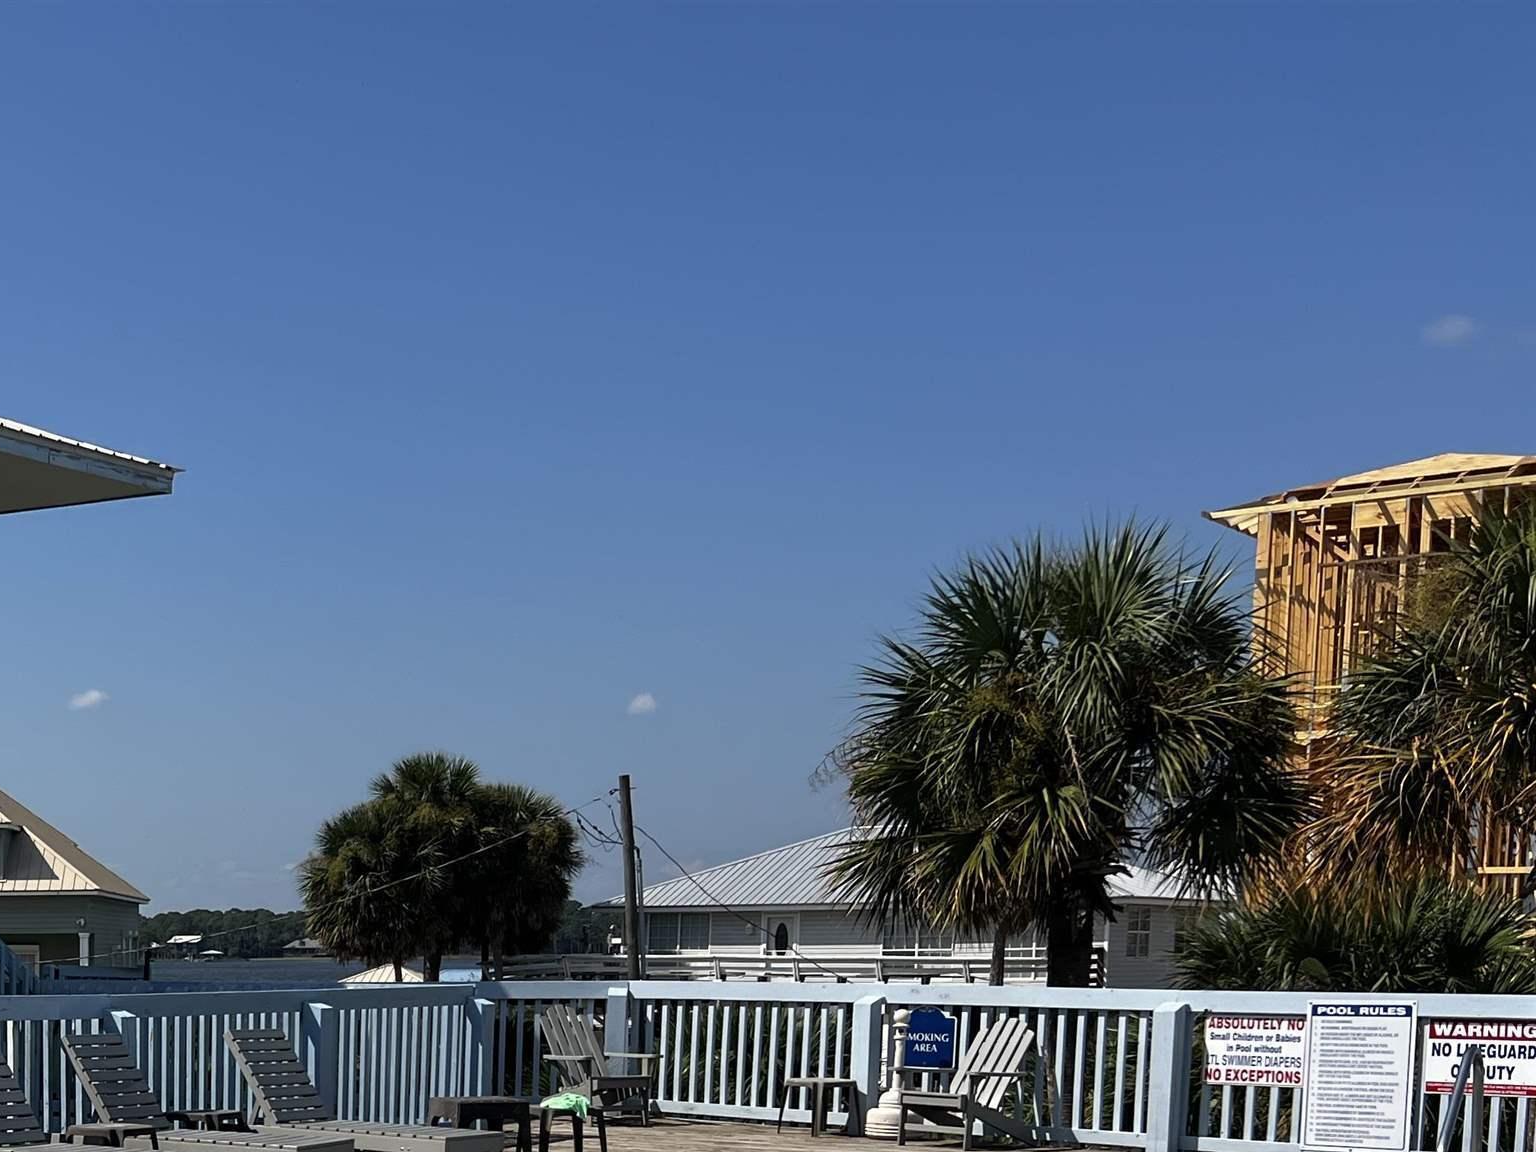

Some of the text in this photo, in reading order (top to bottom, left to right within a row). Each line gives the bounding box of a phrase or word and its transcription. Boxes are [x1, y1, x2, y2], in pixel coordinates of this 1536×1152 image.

[1317, 1006, 1406, 1016] POOL RULES
[1208, 1017, 1304, 1030] ABSOLUTELY NO
[908, 1032, 949, 1042] MOKING
[1210, 1032, 1230, 1040] Small
[1233, 1033, 1263, 1041] Children
[1275, 1034, 1301, 1042] Babies
[1434, 1023, 1536, 1038] WARNING
[912, 1043, 937, 1052] AREA
[1254, 1045, 1282, 1053] without
[1432, 1043, 1451, 1057] NO
[1222, 1055, 1262, 1066] SWIMMER
[1264, 1056, 1301, 1068] DIAPERS
[1205, 1068, 1301, 1084] NO EXCEPTIONS
[1484, 1065, 1515, 1080] UTY
